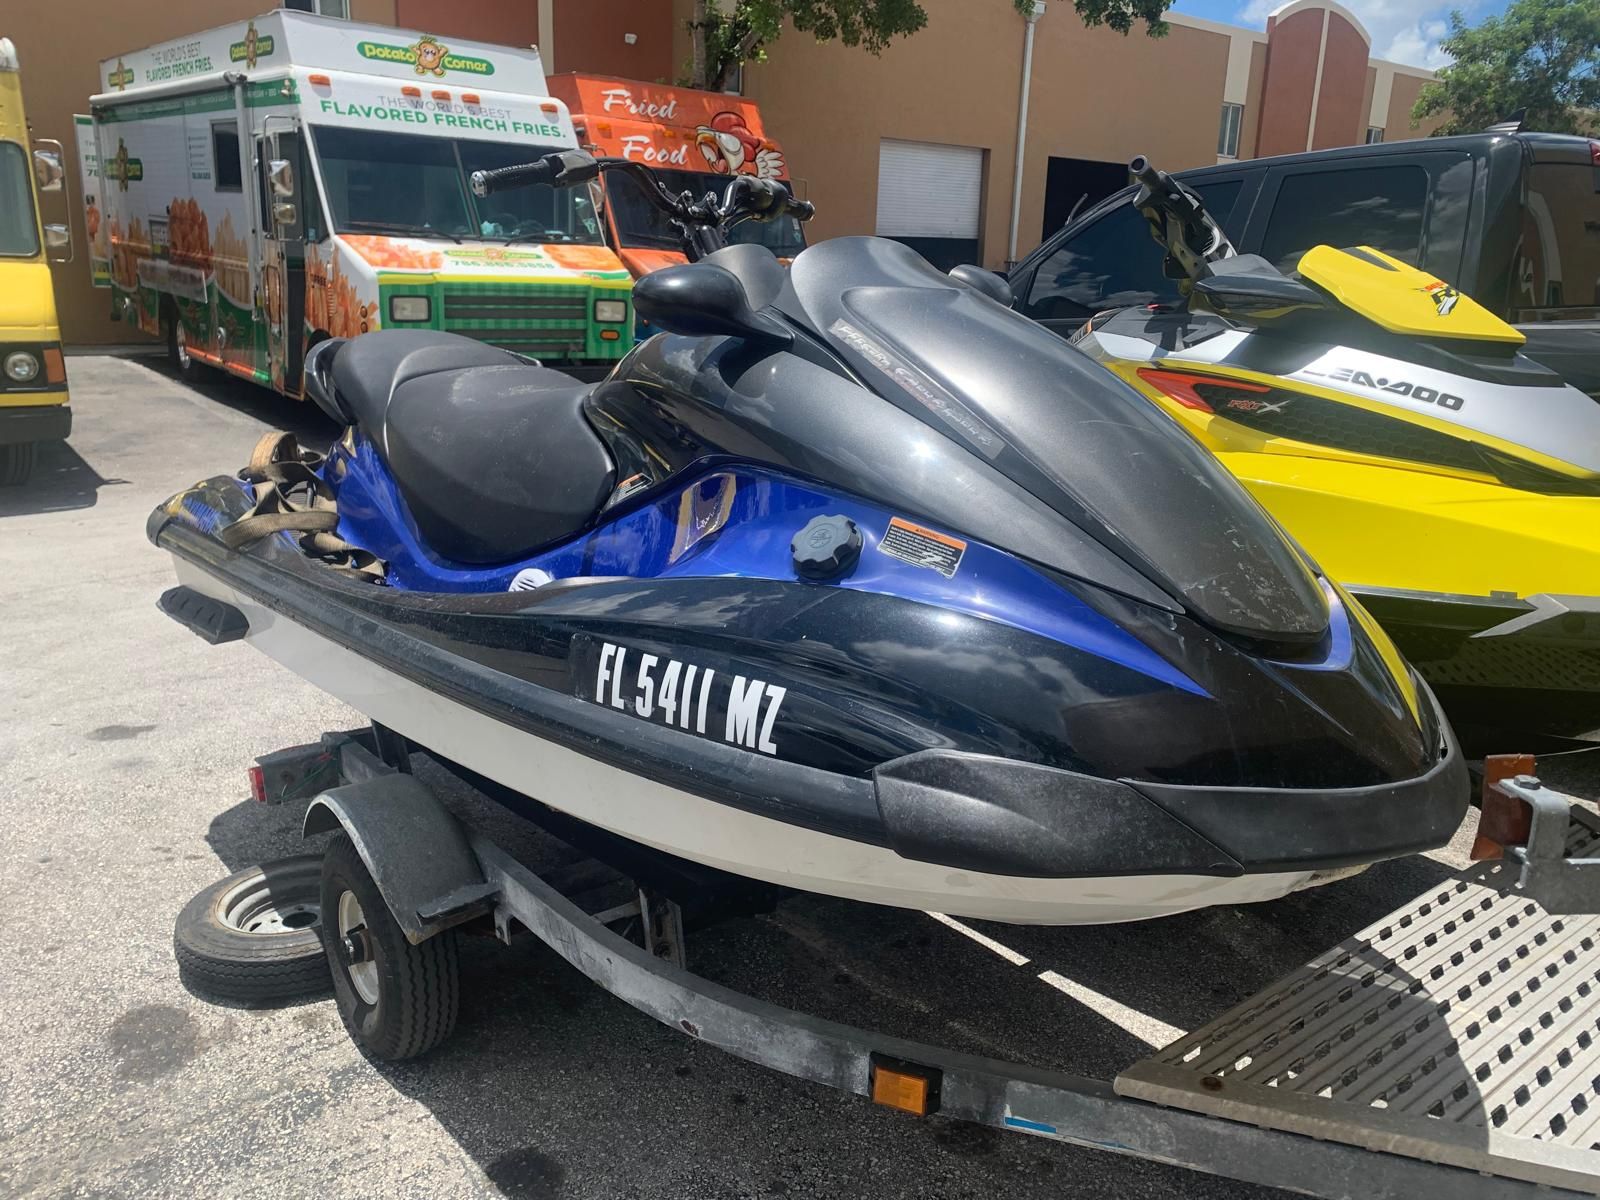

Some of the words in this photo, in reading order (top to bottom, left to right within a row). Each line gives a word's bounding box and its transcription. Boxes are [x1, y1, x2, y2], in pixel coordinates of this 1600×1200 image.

[146, 65, 171, 81] FLAVORED
[172, 60, 193, 77] FRENCH
[363, 43, 416, 63] Potato
[444, 56, 488, 72] Corner
[320, 100, 428, 124] FLAVORED
[434, 114, 508, 132] FRENCH
[512, 121, 567, 138] FRIES.
[377, 95, 406, 108] THE
[480, 106, 512, 119] BEST
[601, 88, 678, 120] Fried
[620, 135, 689, 165] Food
[595, 642, 627, 710] FL
[635, 653, 716, 734] 5411
[725, 675, 787, 756] MZ
